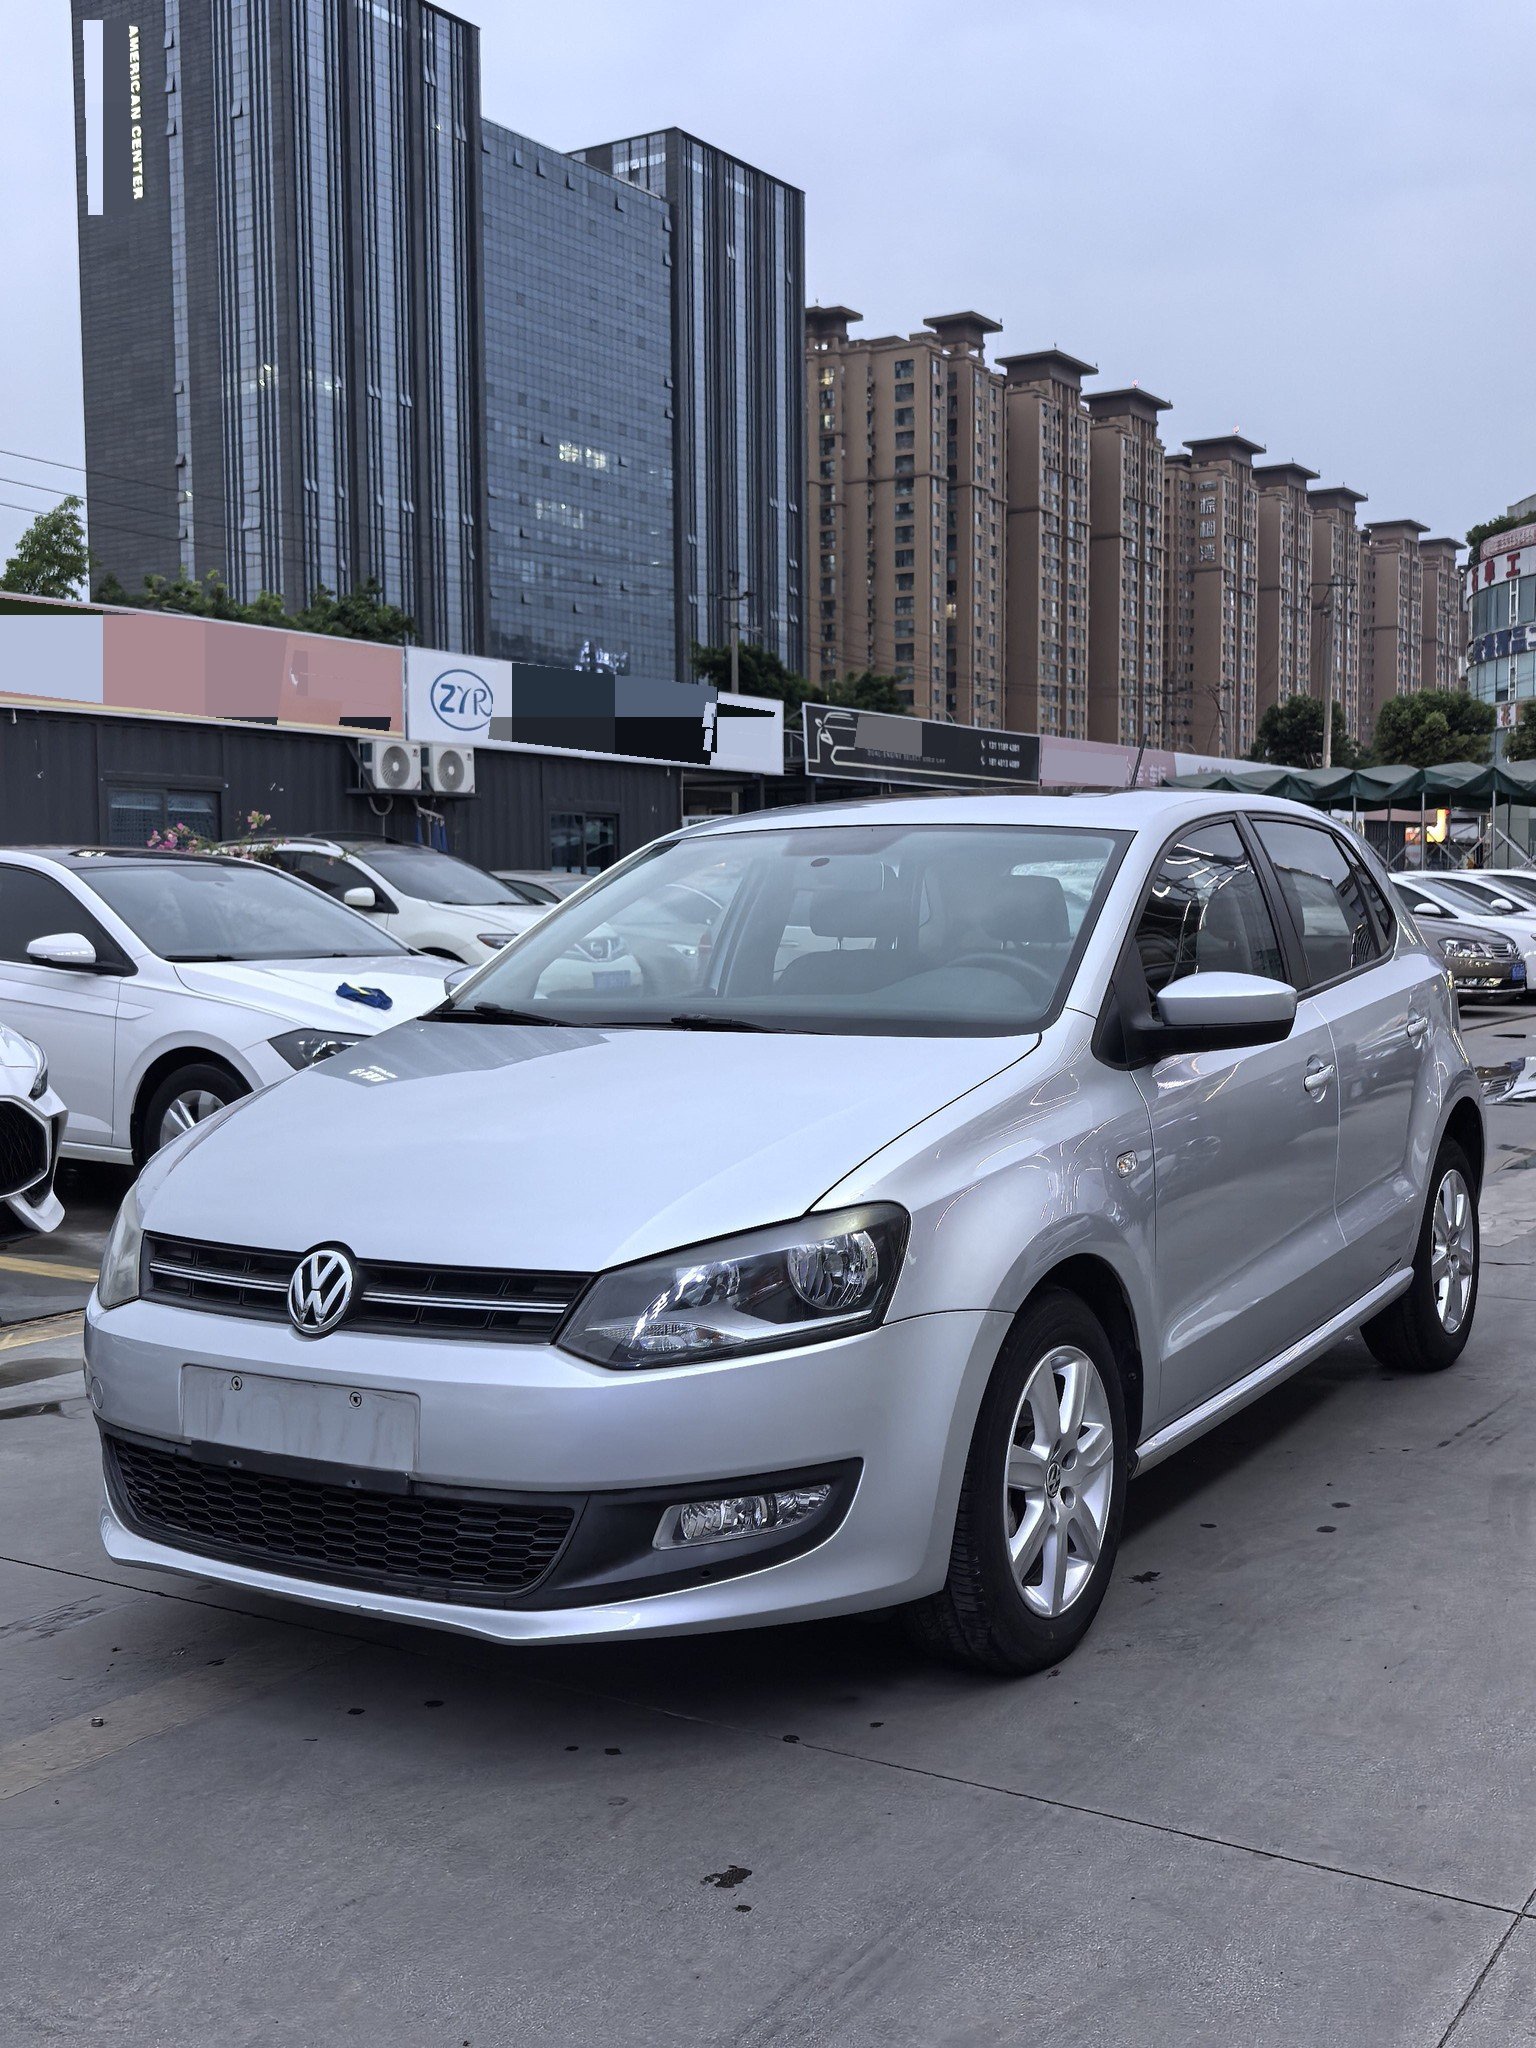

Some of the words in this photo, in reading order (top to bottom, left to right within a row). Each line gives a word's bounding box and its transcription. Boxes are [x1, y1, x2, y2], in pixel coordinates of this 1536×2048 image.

[128, 25, 141, 120] AMERICAN
[132, 125, 144, 200] CENTER
[440, 683, 492, 717] ZYR
